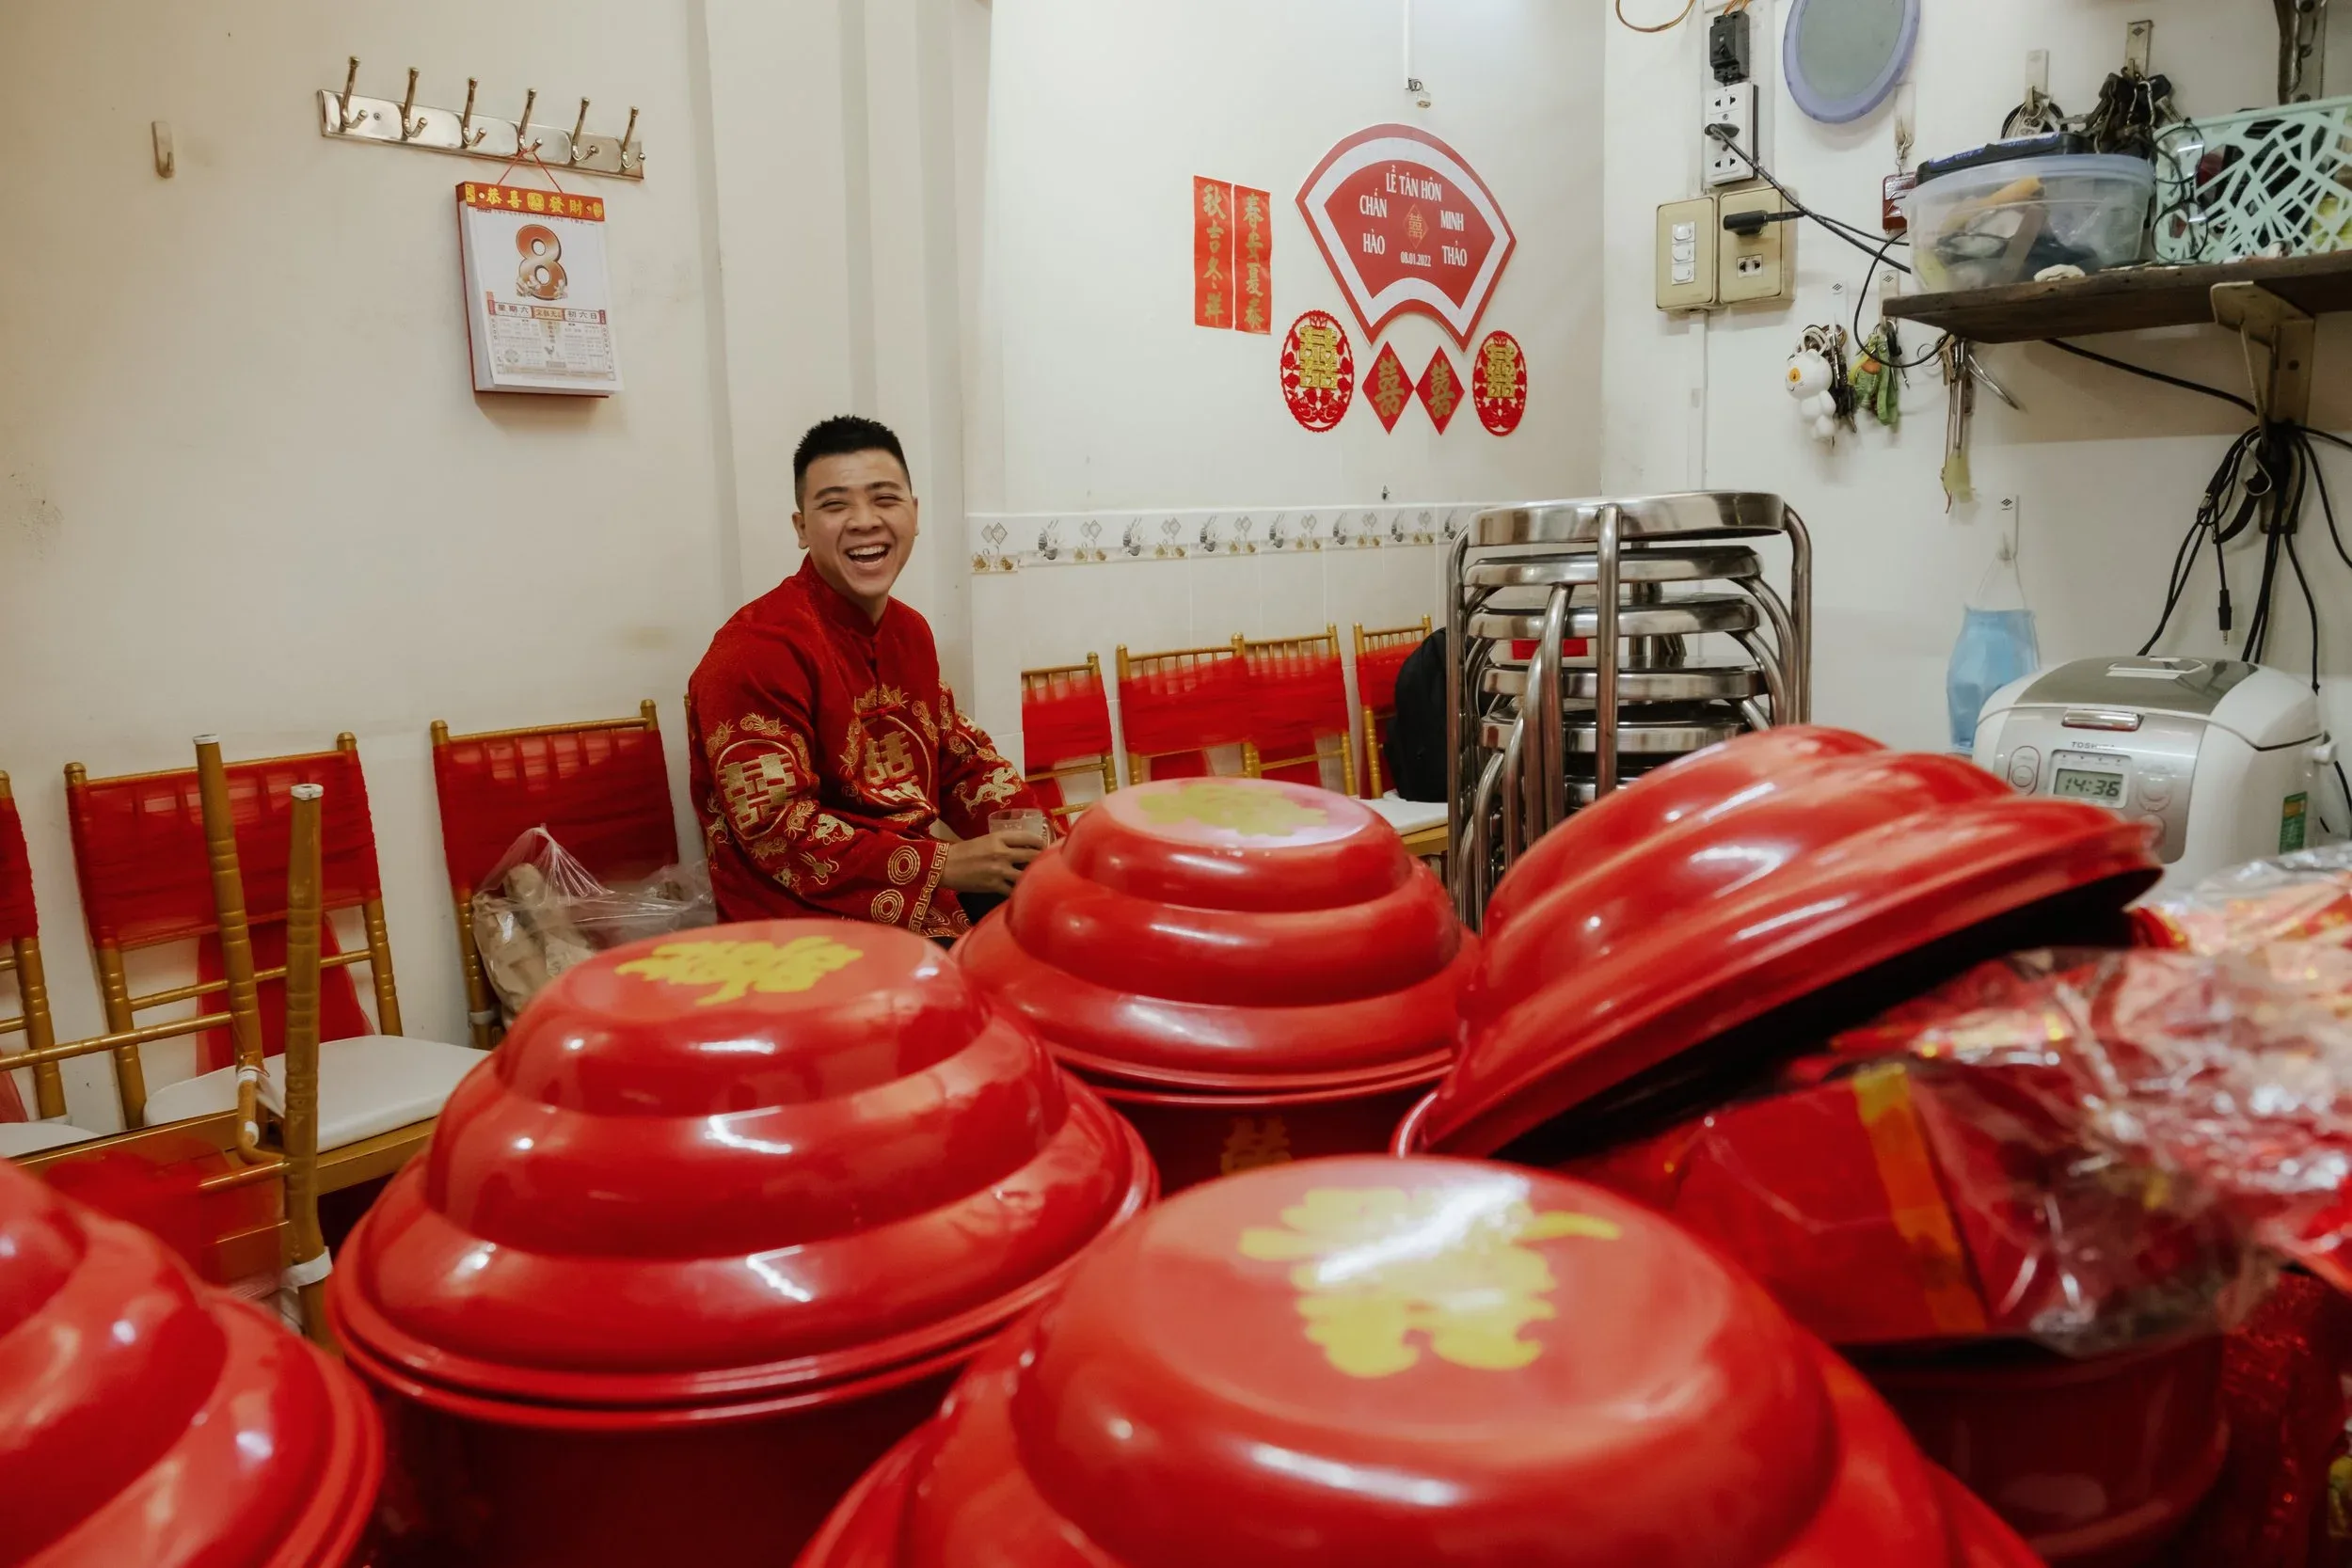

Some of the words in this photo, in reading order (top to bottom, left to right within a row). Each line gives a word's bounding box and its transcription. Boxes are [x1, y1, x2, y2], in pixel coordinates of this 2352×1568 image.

[1399, 171, 1419, 198] TÂN
[1421, 177, 1442, 202] HÔN
[1440, 210, 1464, 232] MINH
[1362, 228, 1386, 256] HÀO
[1441, 240, 1468, 267] THẢO
[516, 224, 567, 300] 8
[1400, 251, 1432, 267] 08.01.2022
[567, 310, 597, 321] 初六日
[2065, 776, 2122, 797] 14:36
